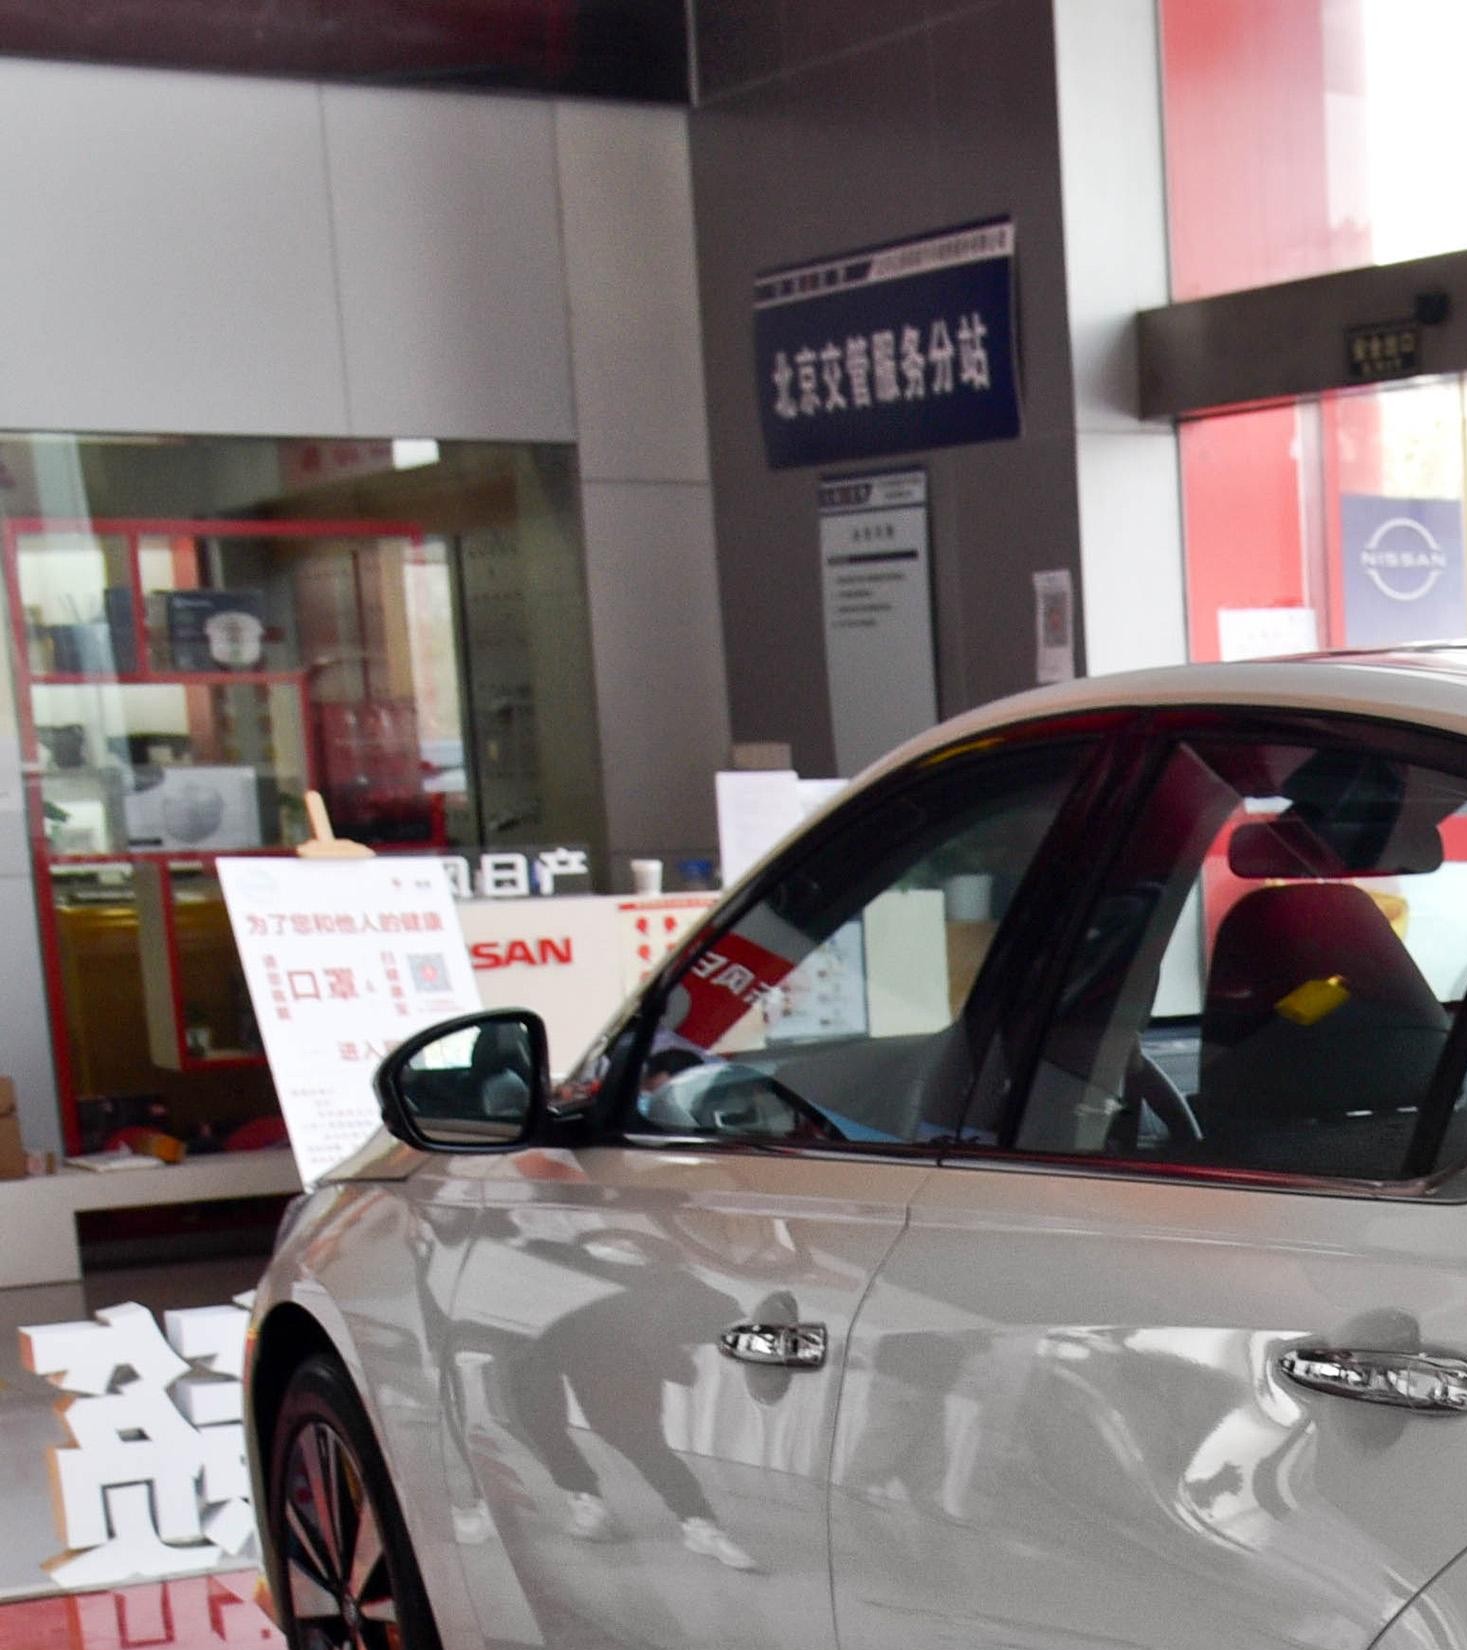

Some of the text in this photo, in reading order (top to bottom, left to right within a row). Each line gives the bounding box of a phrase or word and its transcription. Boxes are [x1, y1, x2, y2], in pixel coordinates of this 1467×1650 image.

[771, 310, 991, 421] 北京交管服务分站
[1360, 550, 1447, 569] NISSAN
